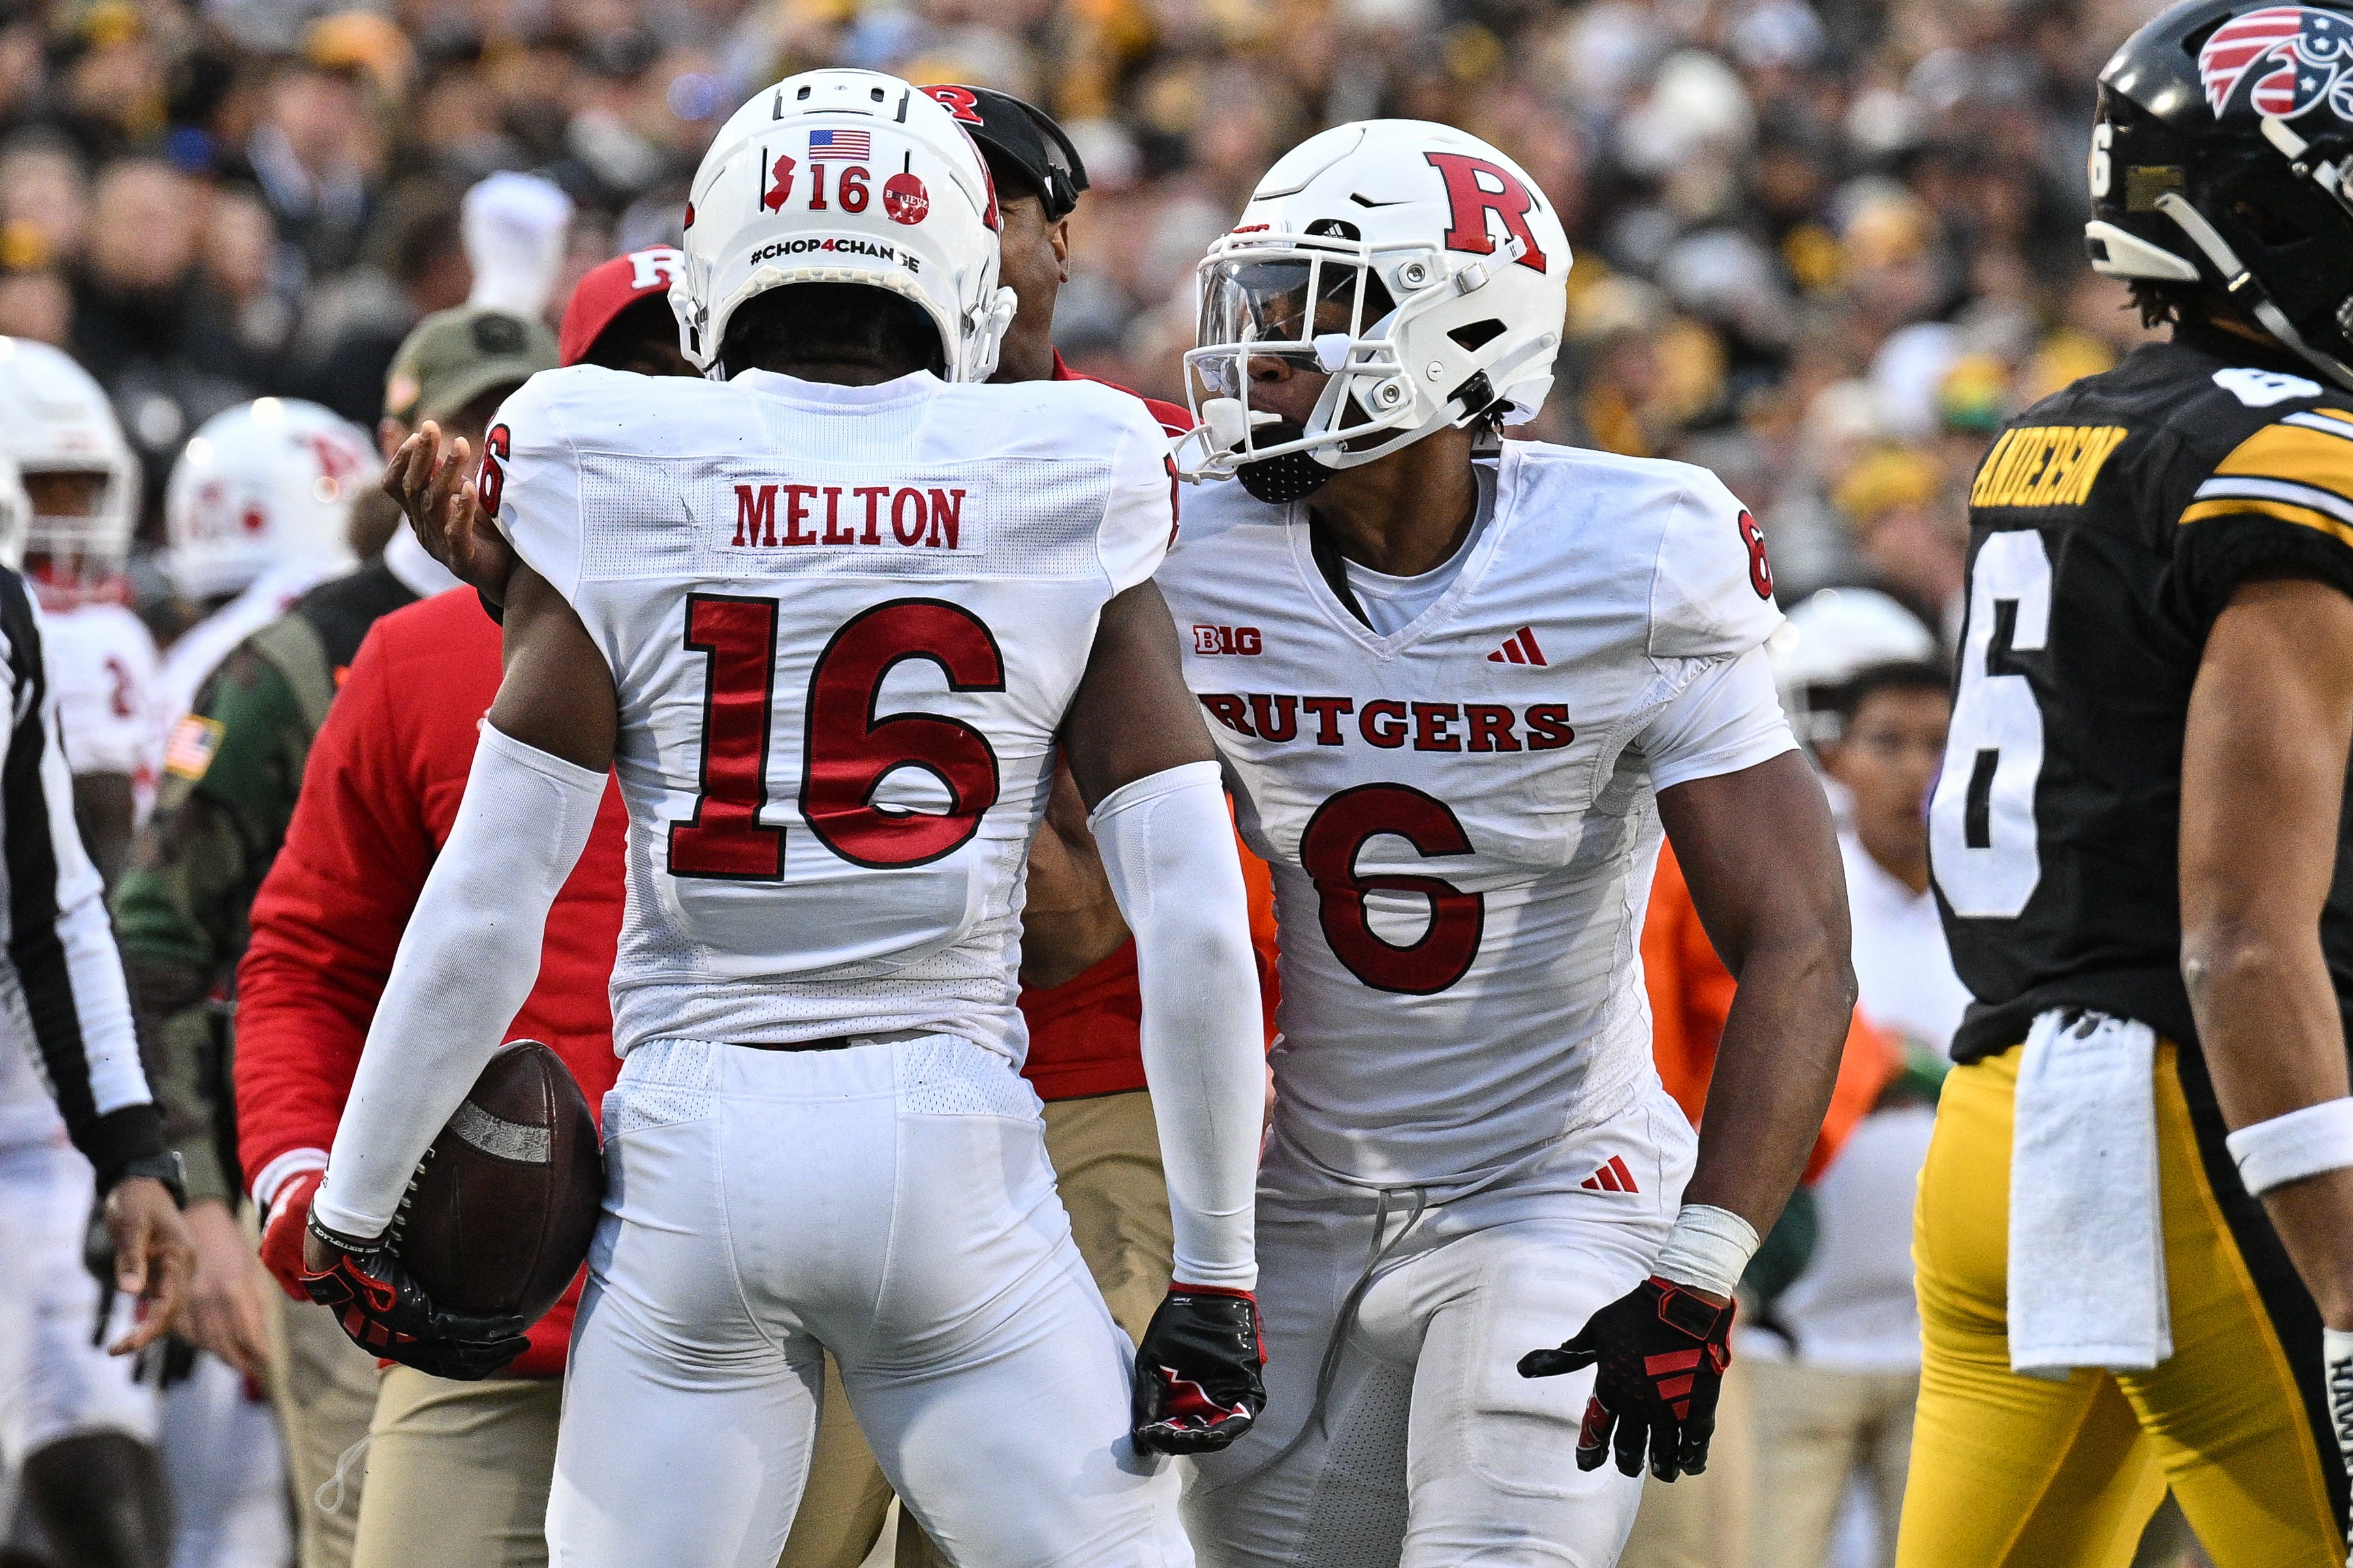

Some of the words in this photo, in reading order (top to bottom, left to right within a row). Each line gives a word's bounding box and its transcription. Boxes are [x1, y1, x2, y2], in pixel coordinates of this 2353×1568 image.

[808, 163, 871, 213] 16
[1422, 151, 1546, 275] R
[629, 249, 685, 289] R
[1969, 426, 2128, 508] ANDERSON
[731, 485, 966, 550] MELTON
[1737, 509, 1772, 601] 6
[667, 592, 1006, 881] 16
[1197, 693, 1575, 752] RUTGERS
[1929, 529, 2052, 919] 6
[1300, 782, 1485, 995] 6
